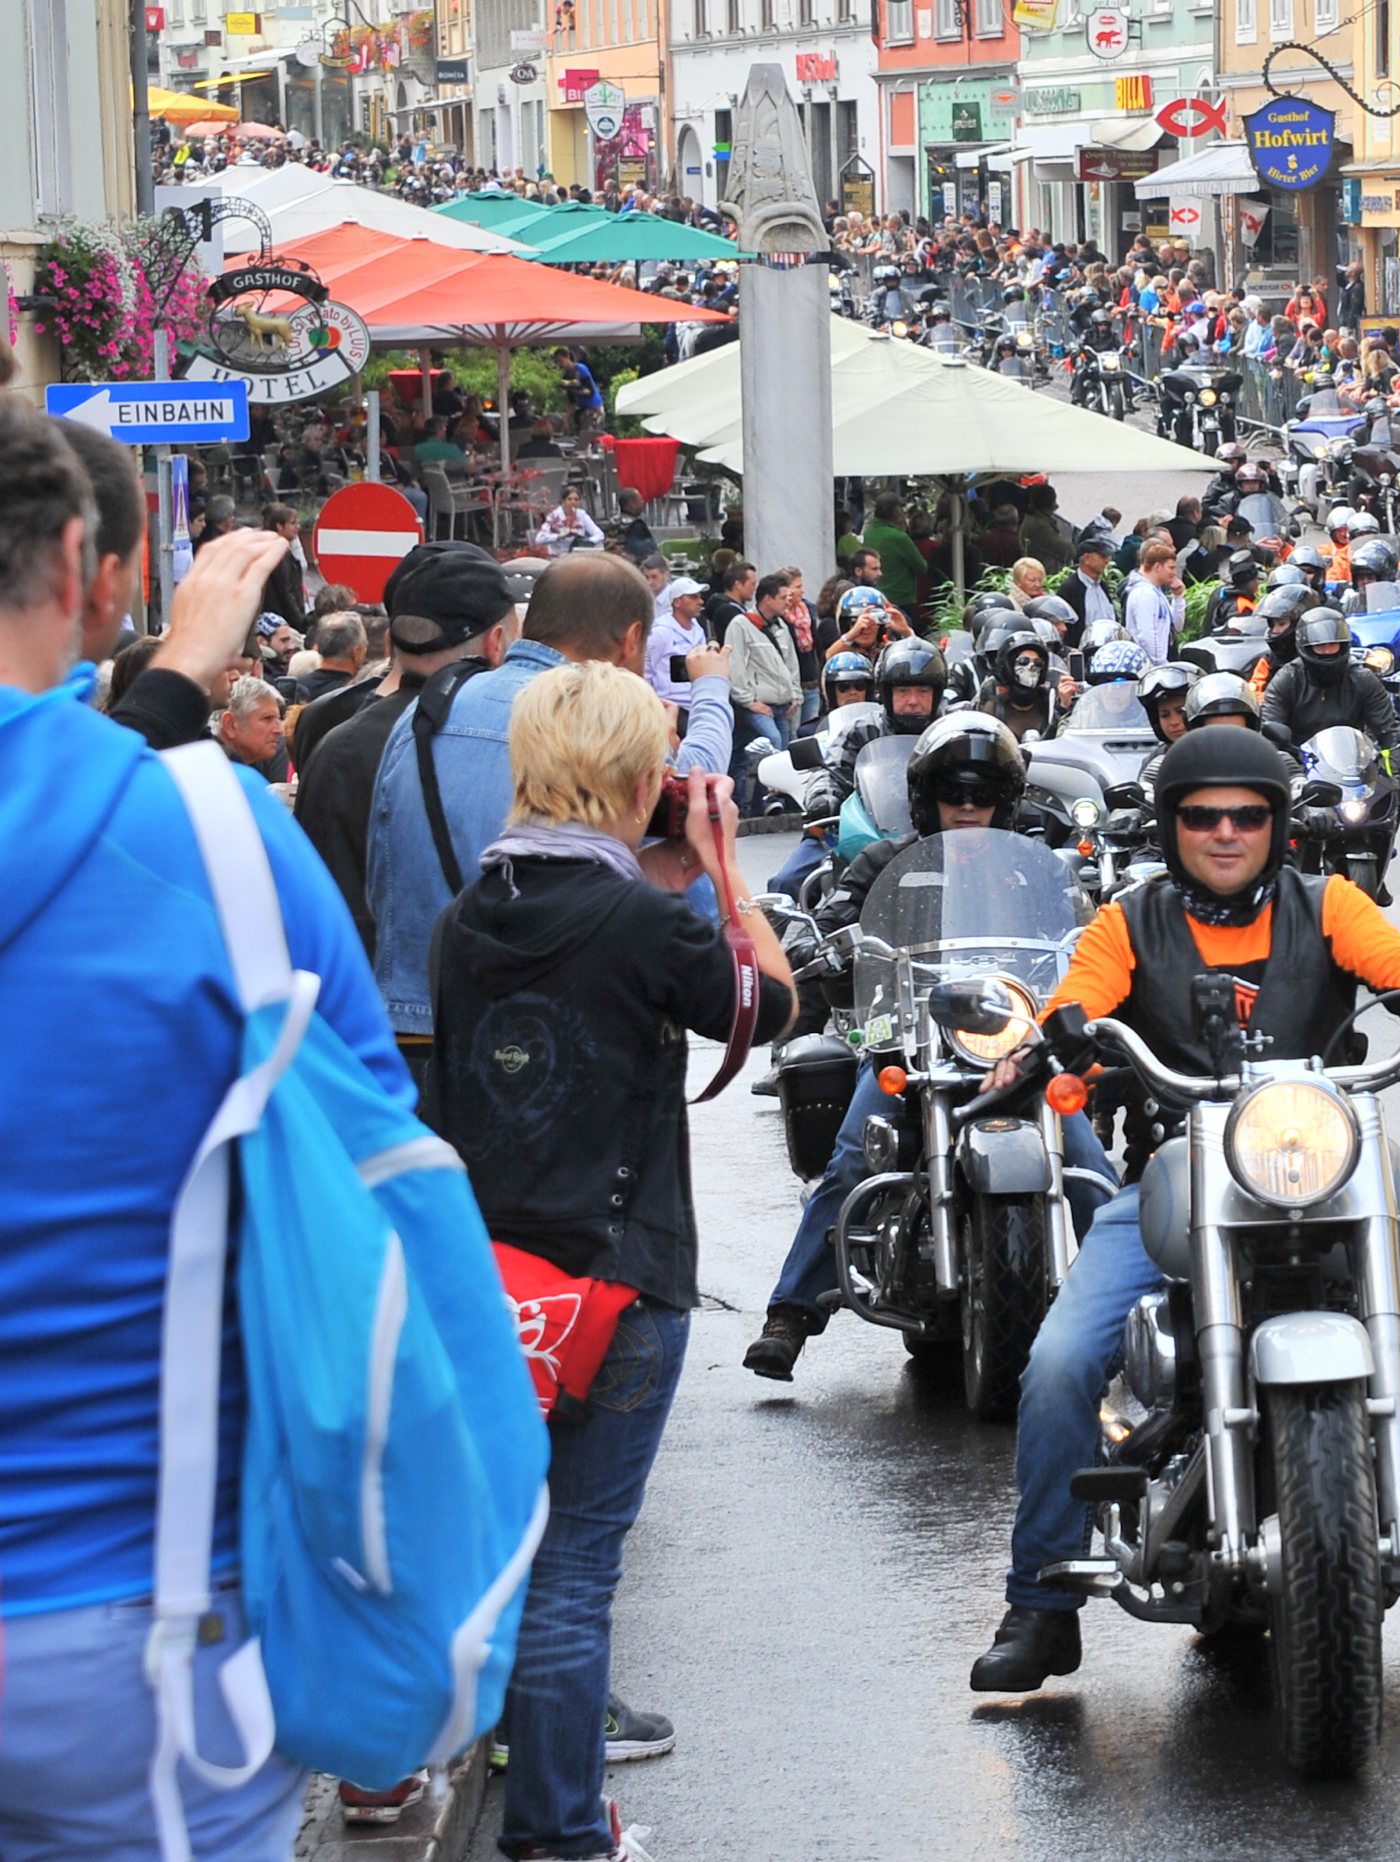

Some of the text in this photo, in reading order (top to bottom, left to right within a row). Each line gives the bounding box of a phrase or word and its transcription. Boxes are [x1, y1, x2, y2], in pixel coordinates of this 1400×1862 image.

[1115, 75, 1145, 109] BILLA
[1268, 111, 1310, 123] Gasthof
[1254, 128, 1329, 148] Hofwirt
[1267, 164, 1319, 183] Hirter Bier
[233, 272, 303, 288] GASTHOF
[340, 315, 355, 331] by
[118, 402, 224, 423] EINBAHN
[740, 964, 753, 1008] Nikon
